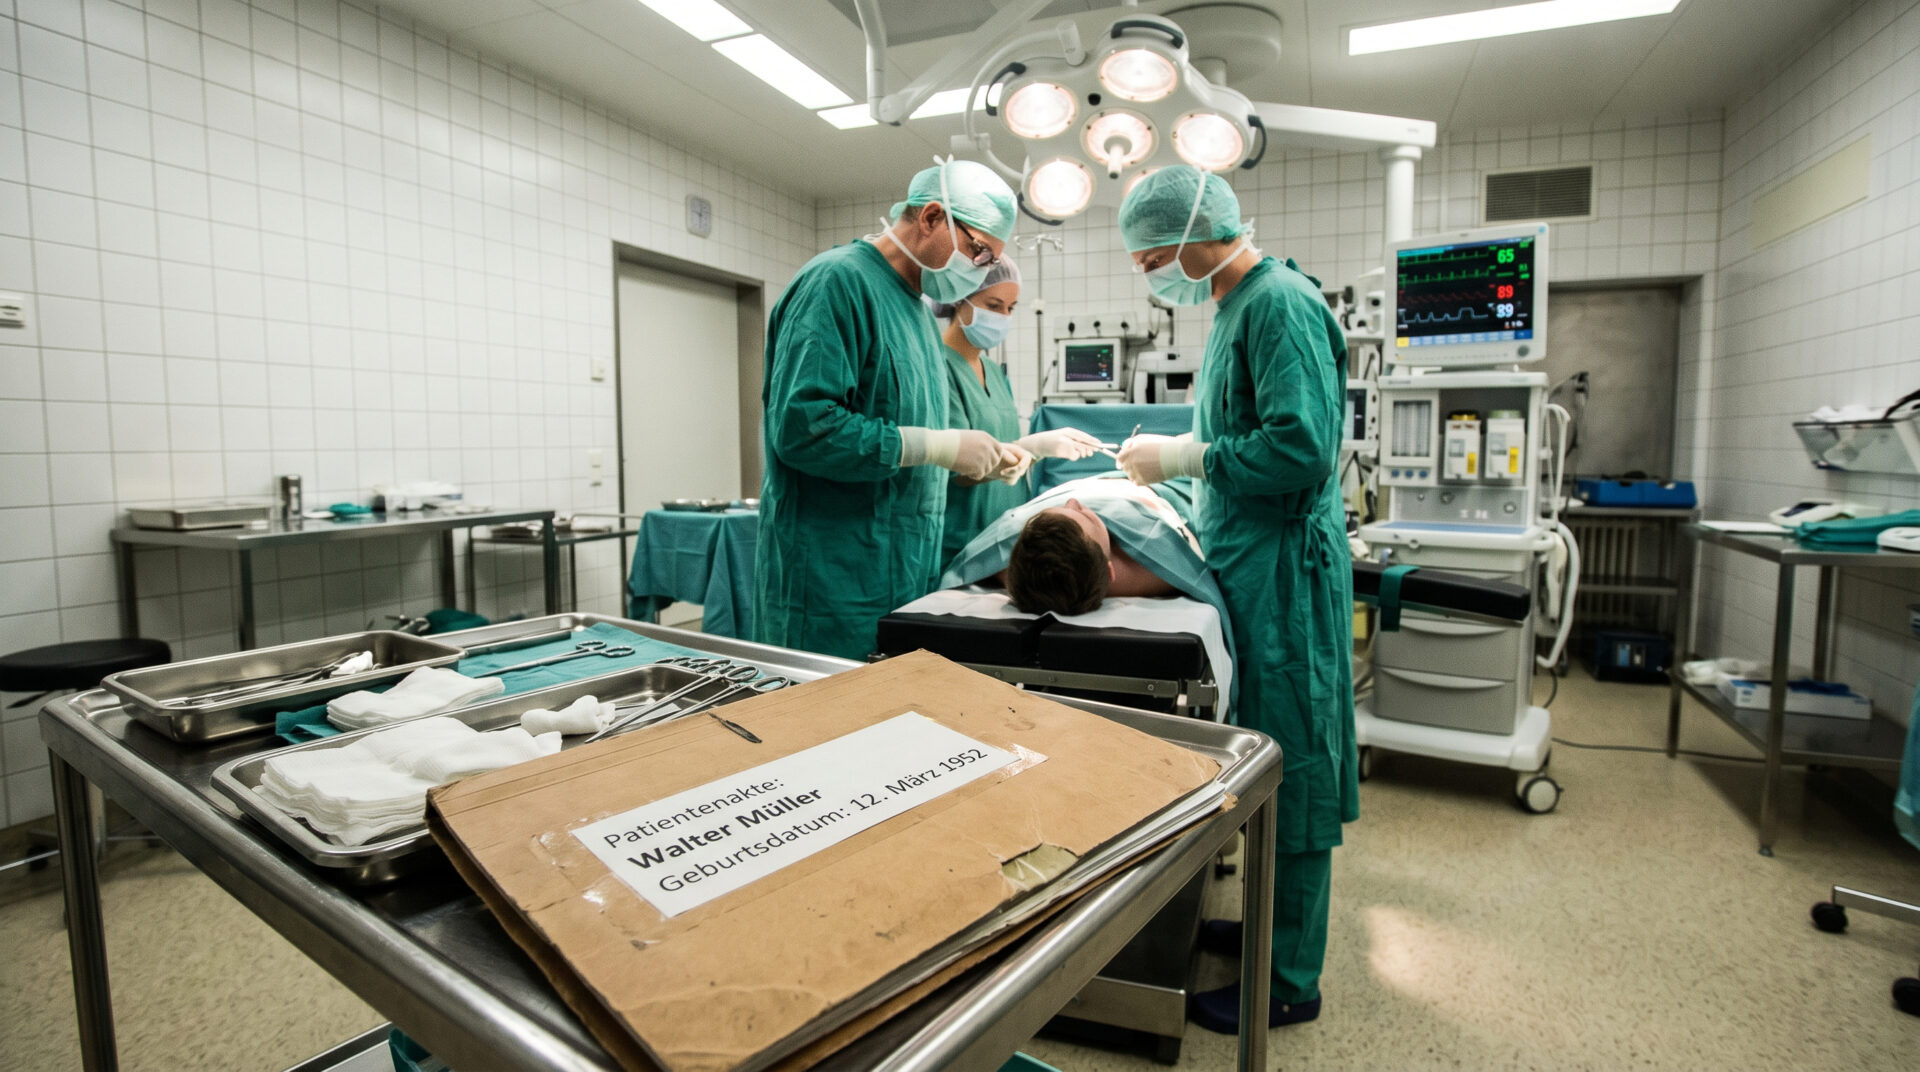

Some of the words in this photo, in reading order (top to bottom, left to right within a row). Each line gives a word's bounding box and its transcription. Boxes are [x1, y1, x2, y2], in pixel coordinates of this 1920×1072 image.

[1497, 248, 1514, 263] 65
[603, 778, 784, 848] Patientenakte:
[627, 823, 732, 869] Walter
[735, 787, 823, 828] Müller
[659, 808, 850, 892] Geburtsdatum:
[850, 793, 888, 811] 12.
[885, 769, 941, 795] März
[939, 749, 988, 772] 1952
